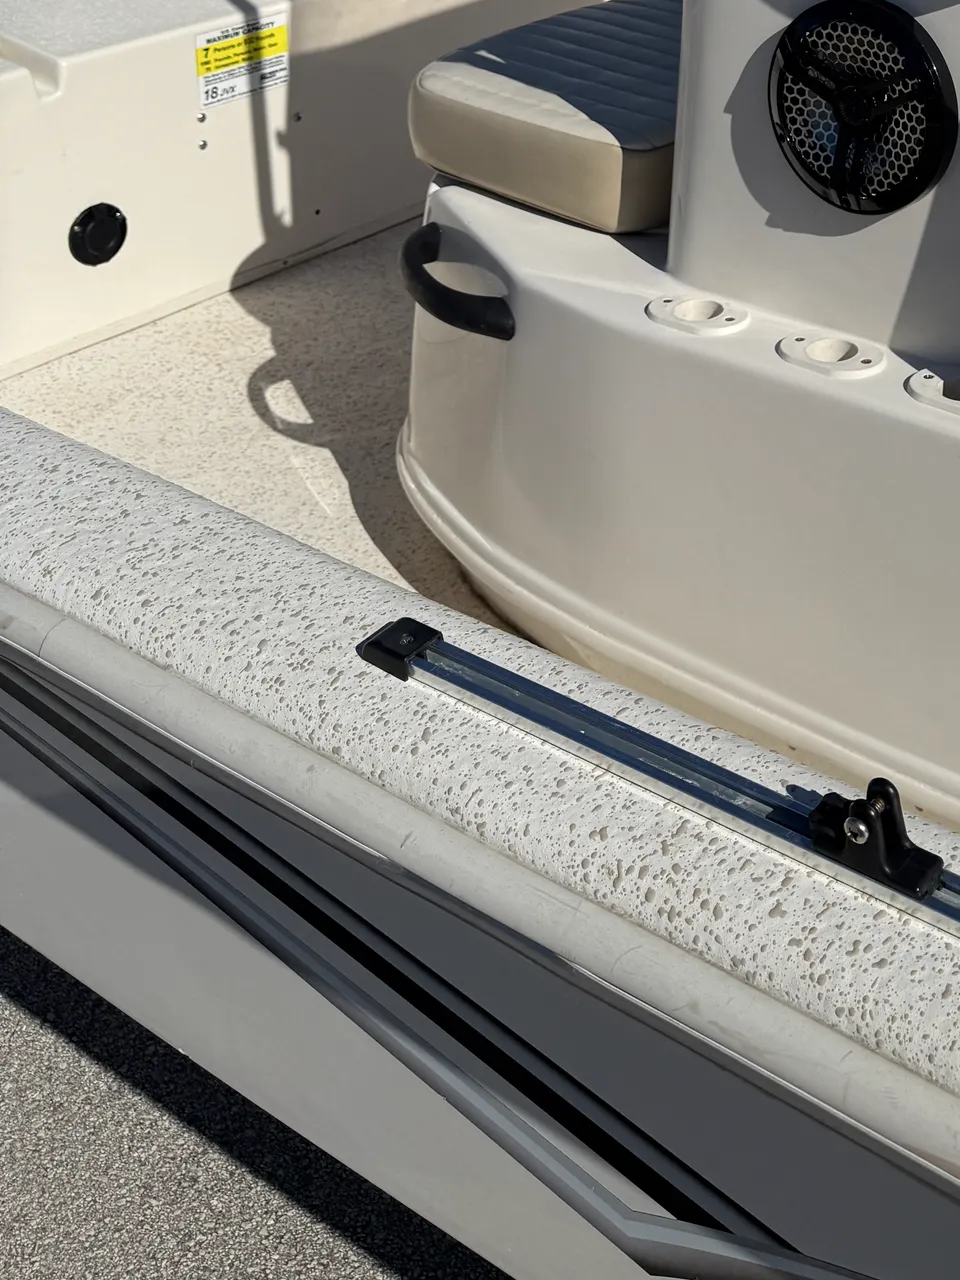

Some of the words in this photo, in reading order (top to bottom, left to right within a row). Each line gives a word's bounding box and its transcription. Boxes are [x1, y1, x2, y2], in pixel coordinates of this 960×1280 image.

[206, 31, 240, 44] MAXIMUM
[242, 21, 275, 35] CAPACITY
[203, 47, 210, 58] 7
[204, 87, 219, 101] 18
